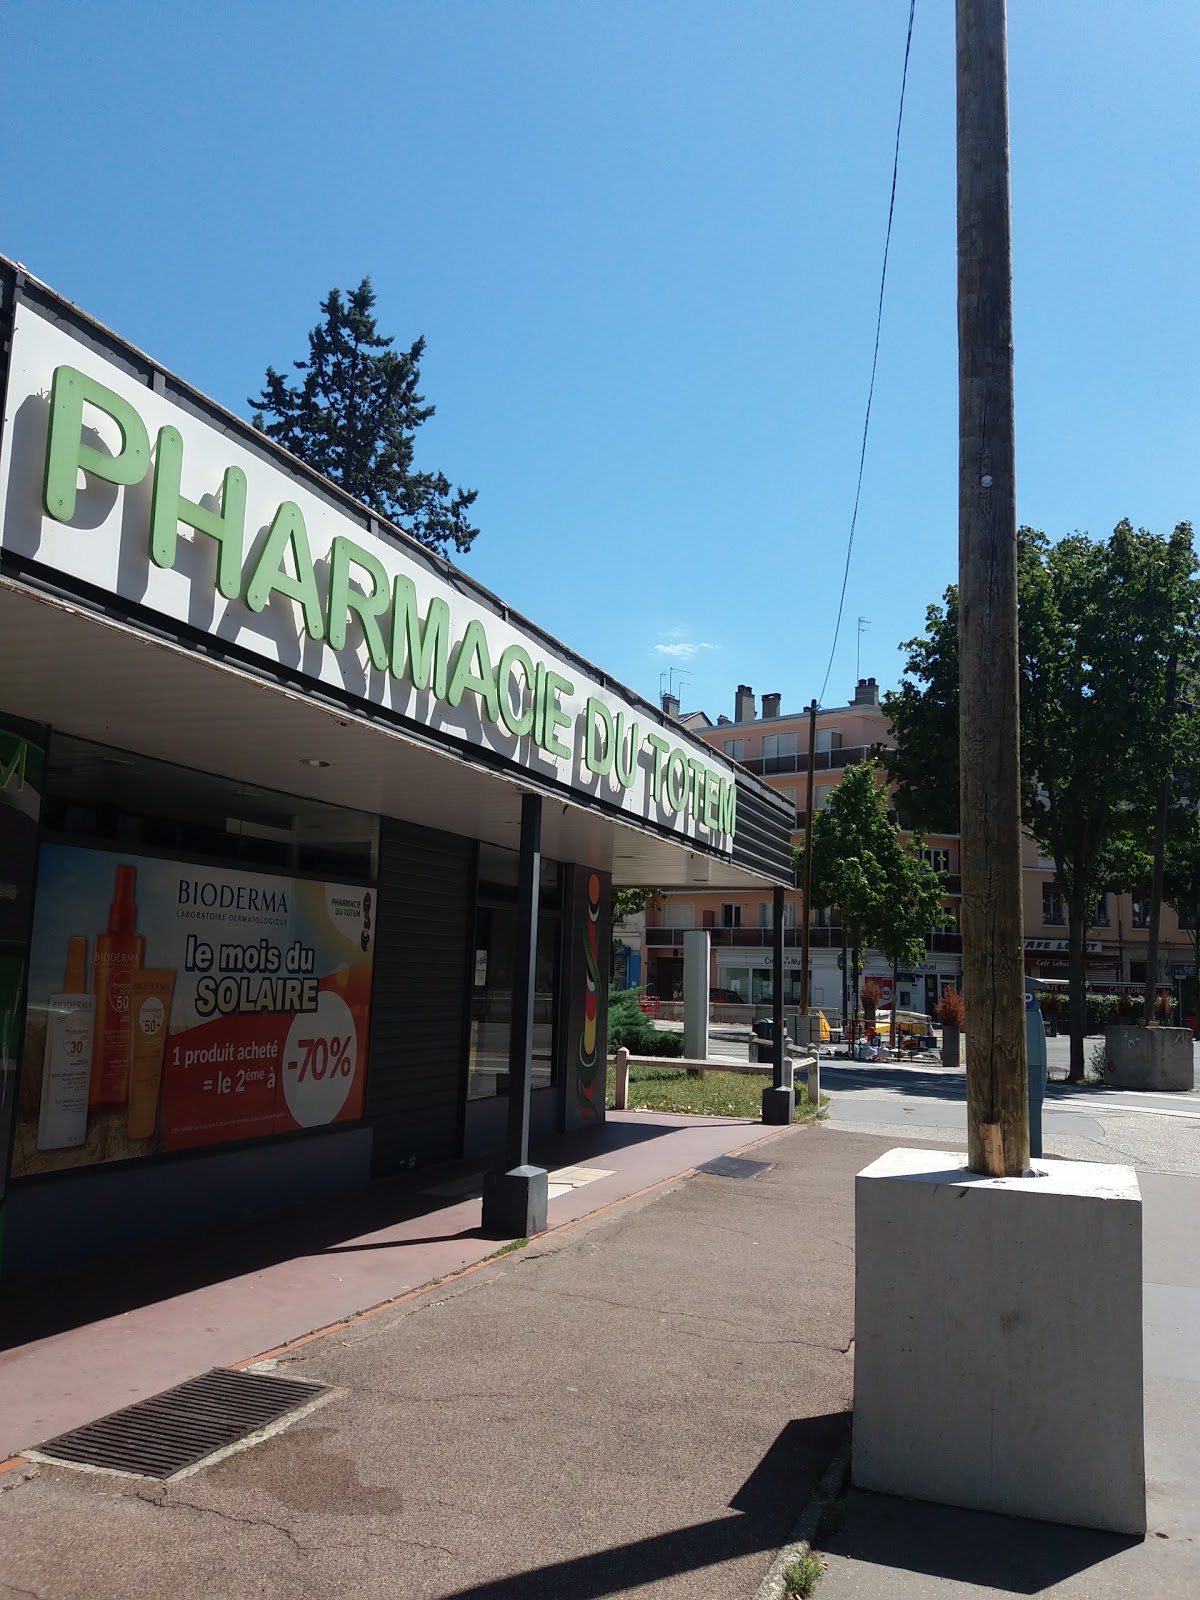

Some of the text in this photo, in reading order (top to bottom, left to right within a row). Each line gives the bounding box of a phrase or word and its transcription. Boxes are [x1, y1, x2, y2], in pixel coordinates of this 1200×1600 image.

[42, 364, 737, 838] PHARMACIE DU TOTEM
[178, 879, 289, 914] BIODERMA
[331, 898, 362, 918] PHARMACIE DU TOTEM
[176, 909, 288, 927] LABORATOIRE DERMATOLOGIQUE
[95, 952, 140, 963] BIODERMA
[185, 934, 316, 974] le mois du
[1024, 940, 1051, 949] AFE
[195, 975, 320, 1017] SOLAIRE
[145, 1019, 161, 1033] 50+
[71, 1041, 83, 1054] 30
[172, 1040, 278, 1069] 1 produit acheté
[288, 1036, 352, 1083] -70%
[217, 1070, 232, 1094] le
[267, 1066, 276, 1089] à
